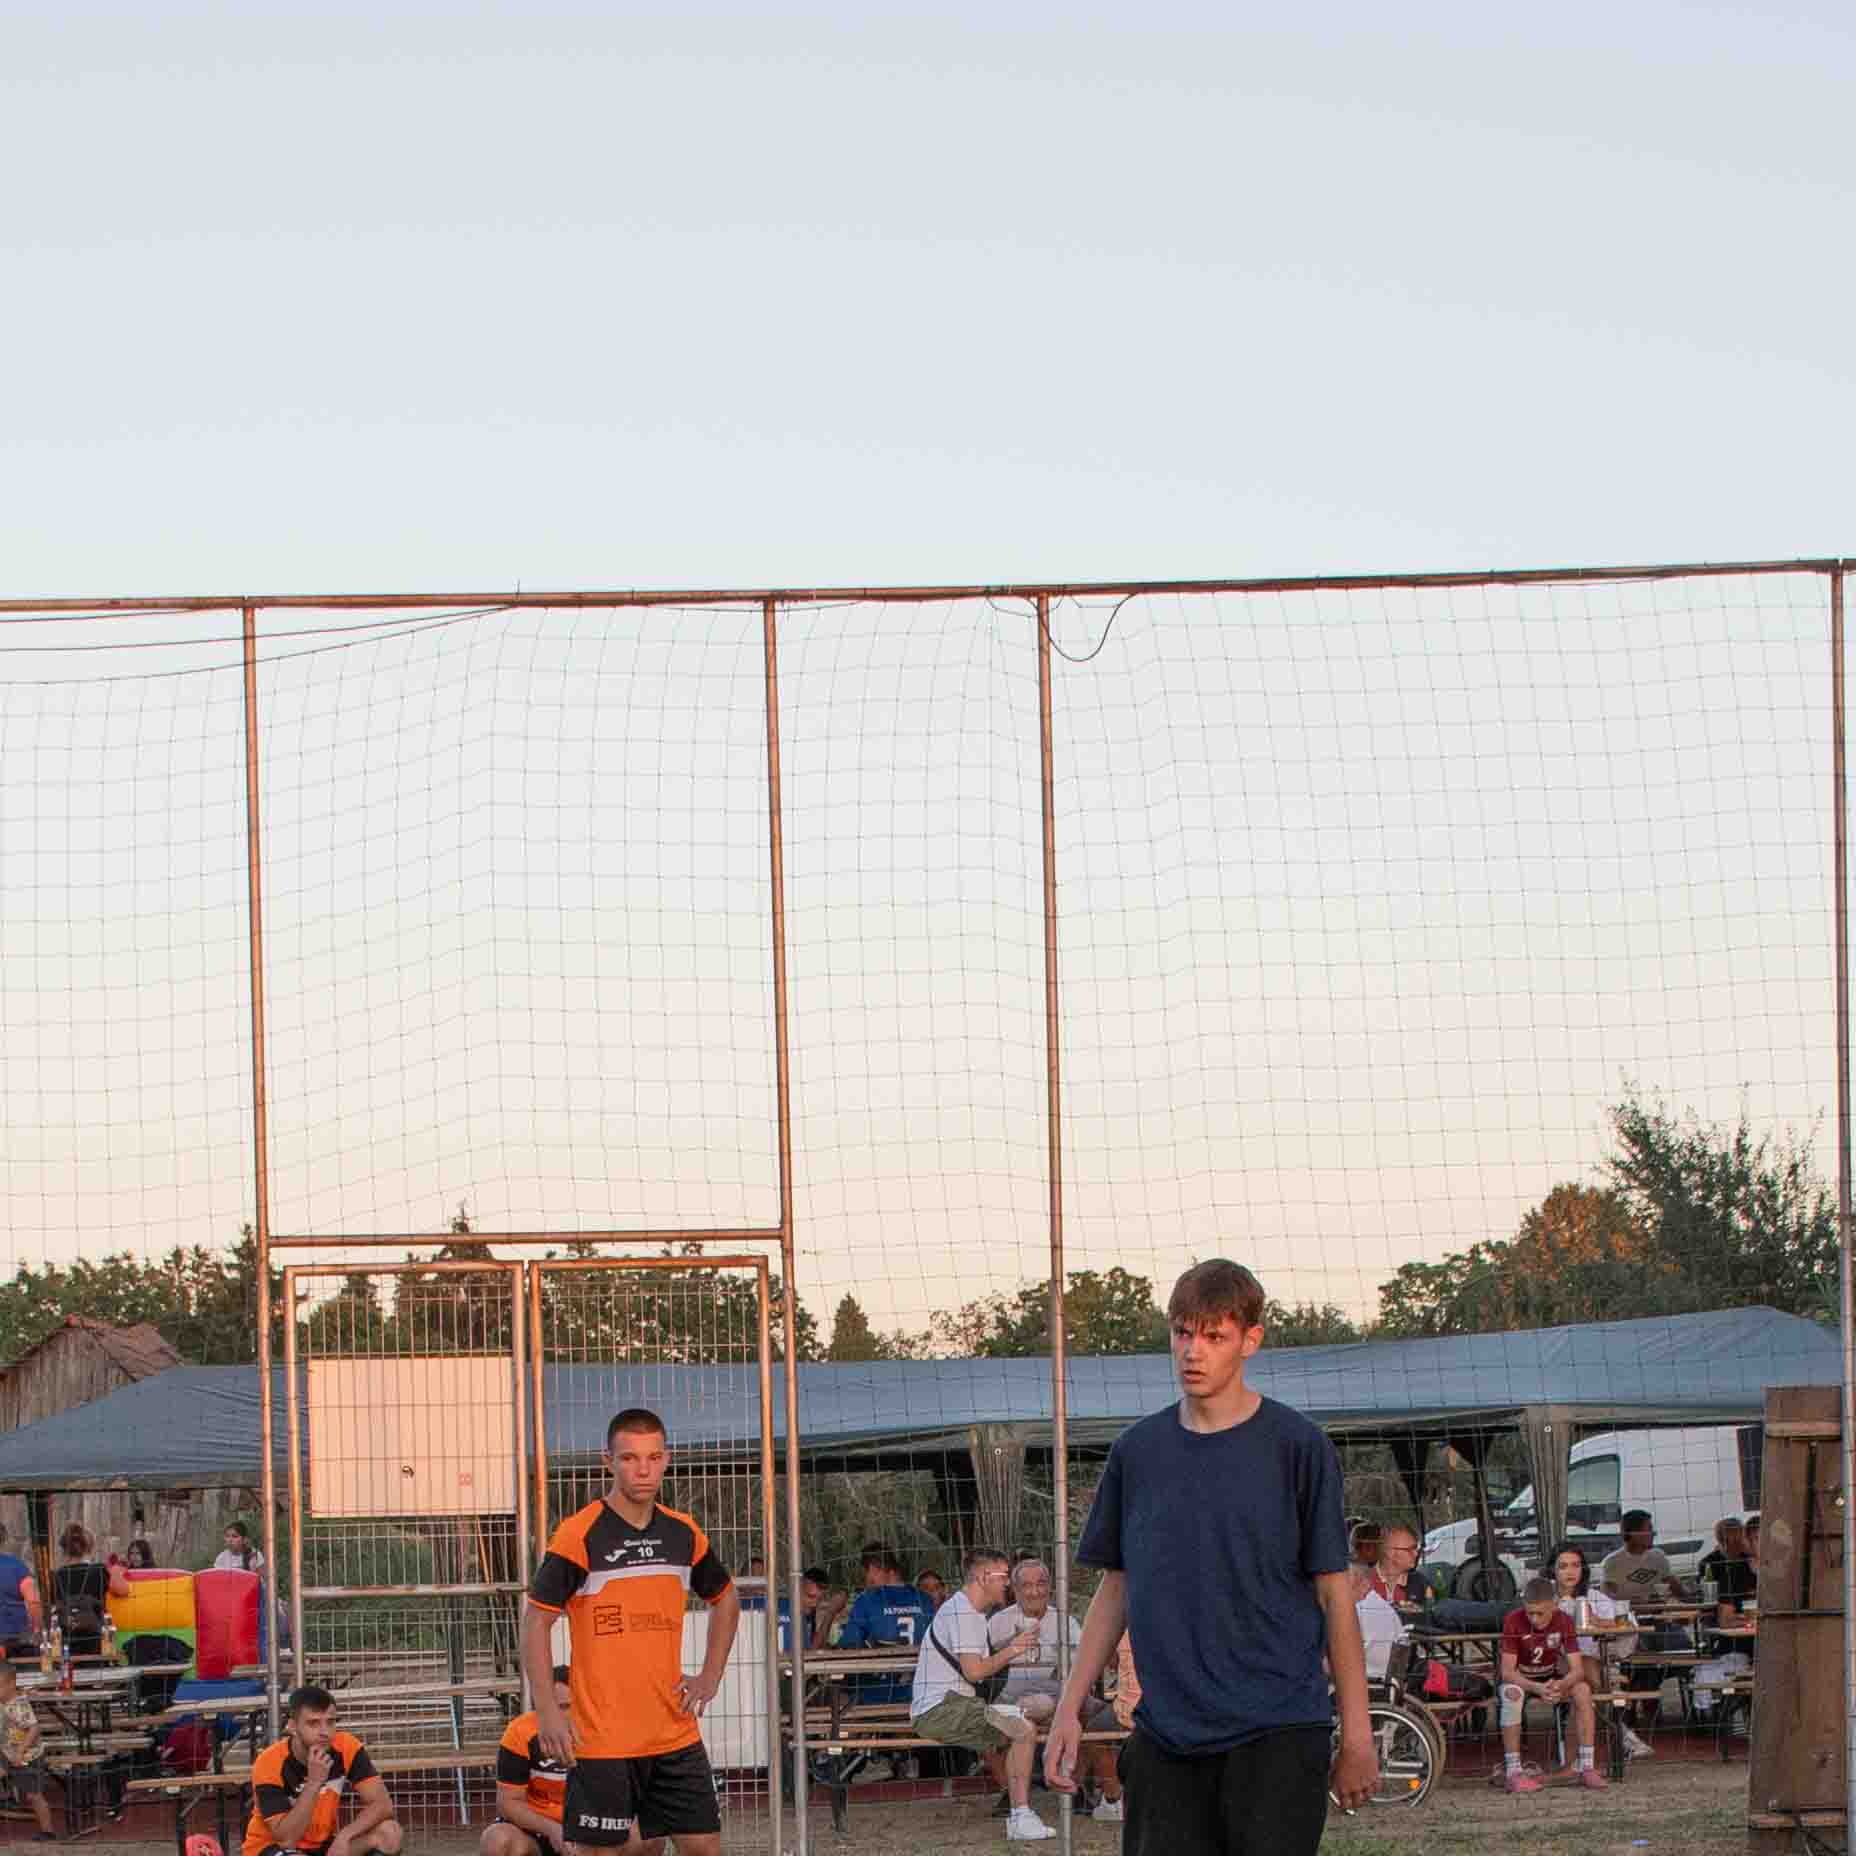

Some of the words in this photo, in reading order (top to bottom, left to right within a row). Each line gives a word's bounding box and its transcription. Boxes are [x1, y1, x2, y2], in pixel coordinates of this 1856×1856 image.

[637, 1546, 654, 1558] 10
[1531, 1647, 1544, 1664] 2
[578, 1814, 600, 1829] FS
